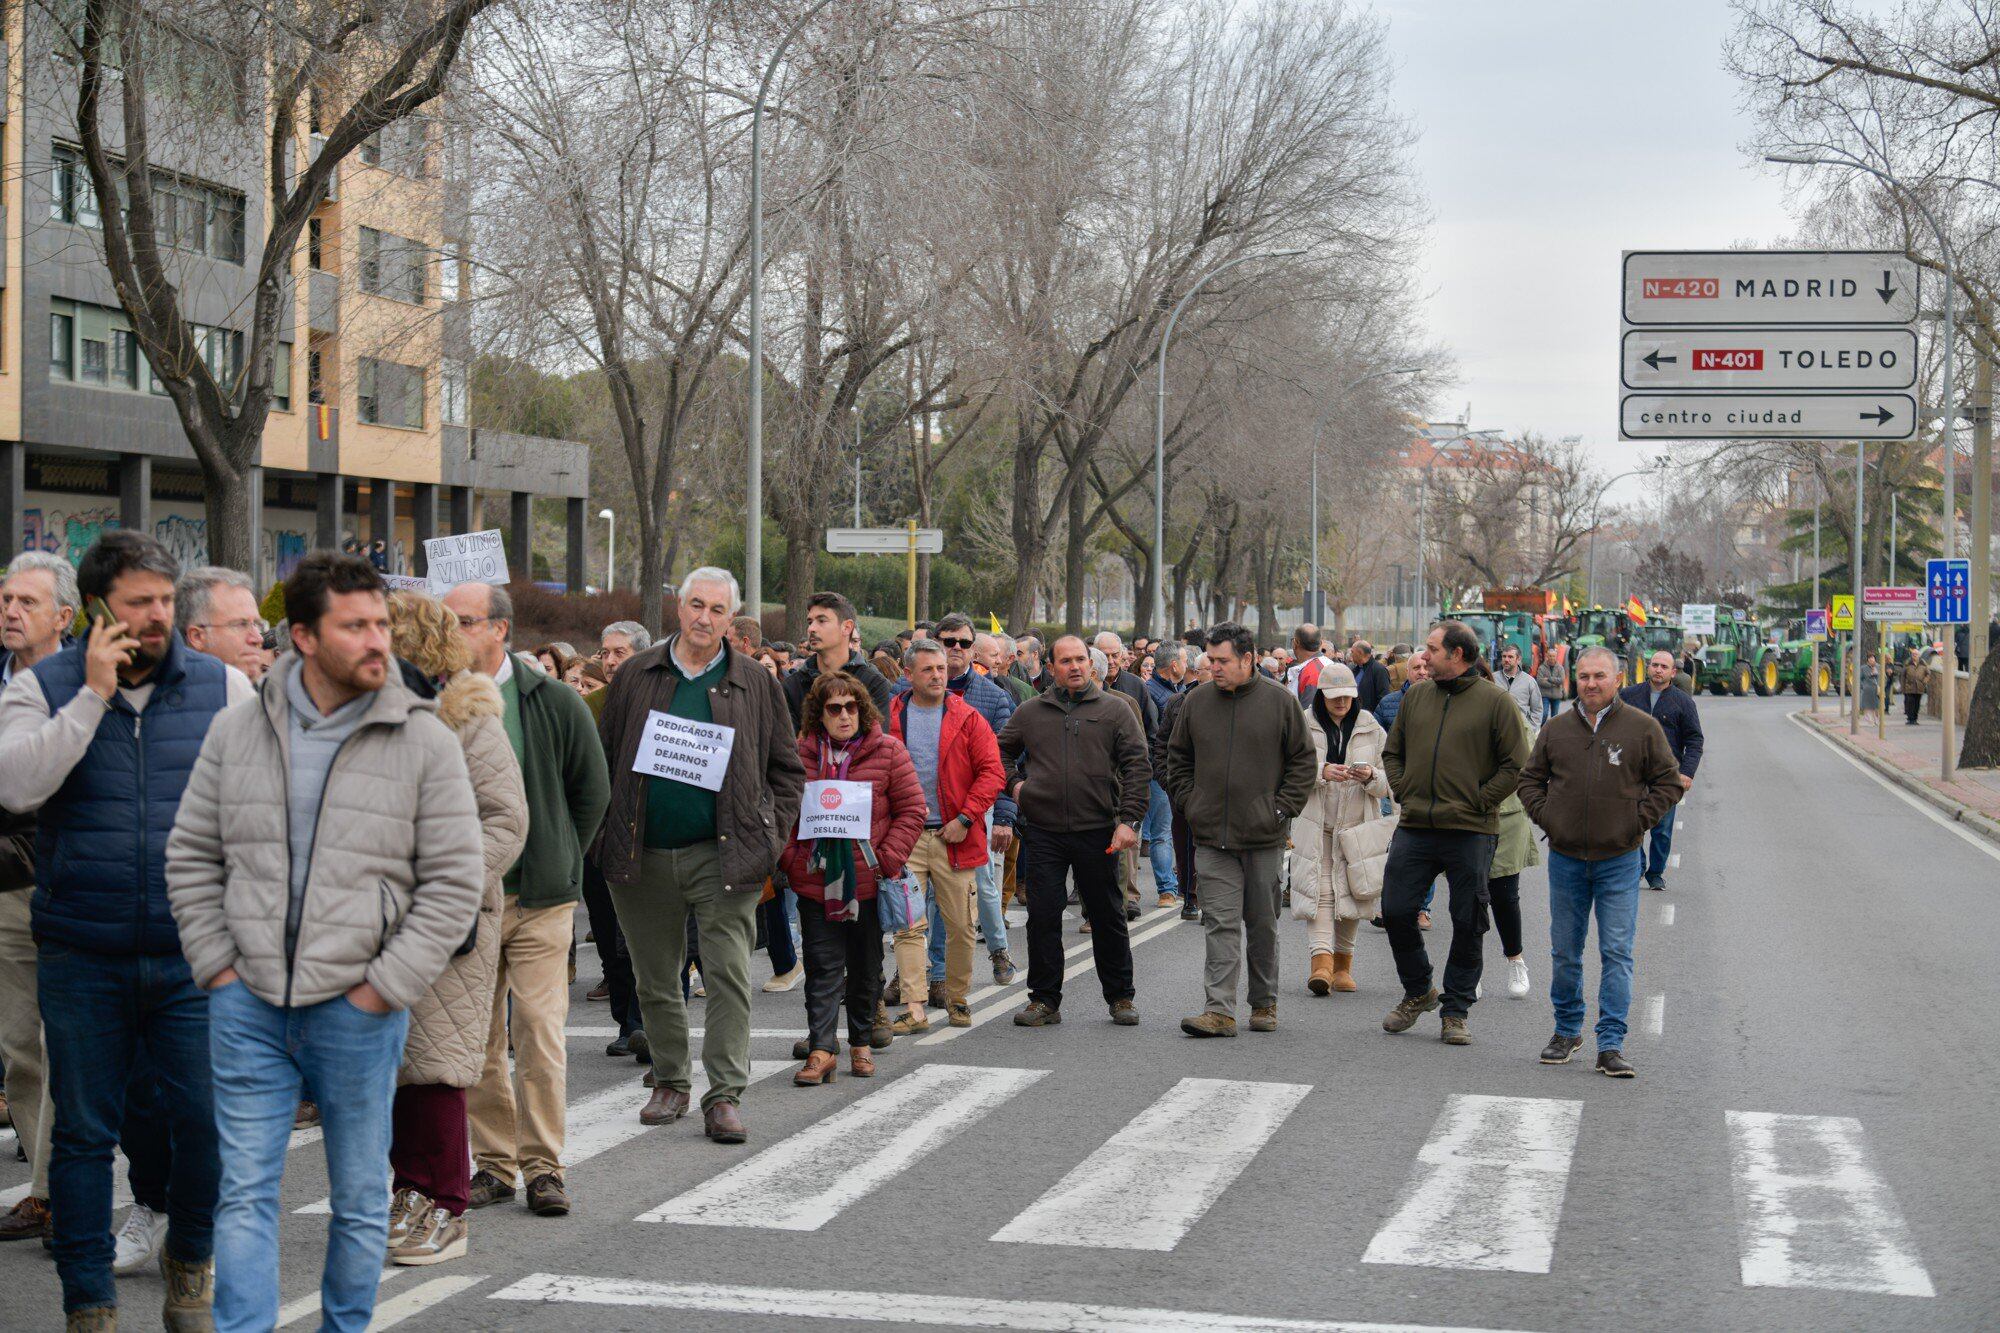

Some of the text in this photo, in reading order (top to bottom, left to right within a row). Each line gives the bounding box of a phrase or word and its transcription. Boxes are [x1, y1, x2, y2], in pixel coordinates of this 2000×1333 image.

[1645, 279, 1858, 298] N-420 MADRID
[1701, 350, 1897, 369] N-401 TOLEDO
[1640, 409, 1801, 424] centro ciudad
[430, 532, 500, 559] AL VINO
[436, 556, 496, 584] VINO
[653, 733, 719, 755] GOBERNAR Y
[715, 732, 723, 741] A
[654, 748, 708, 768] DEJARNOS
[652, 763, 702, 782] SEMBRAR
[821, 794, 841, 804] STOP
[805, 814, 861, 823] COMPETENCIA
